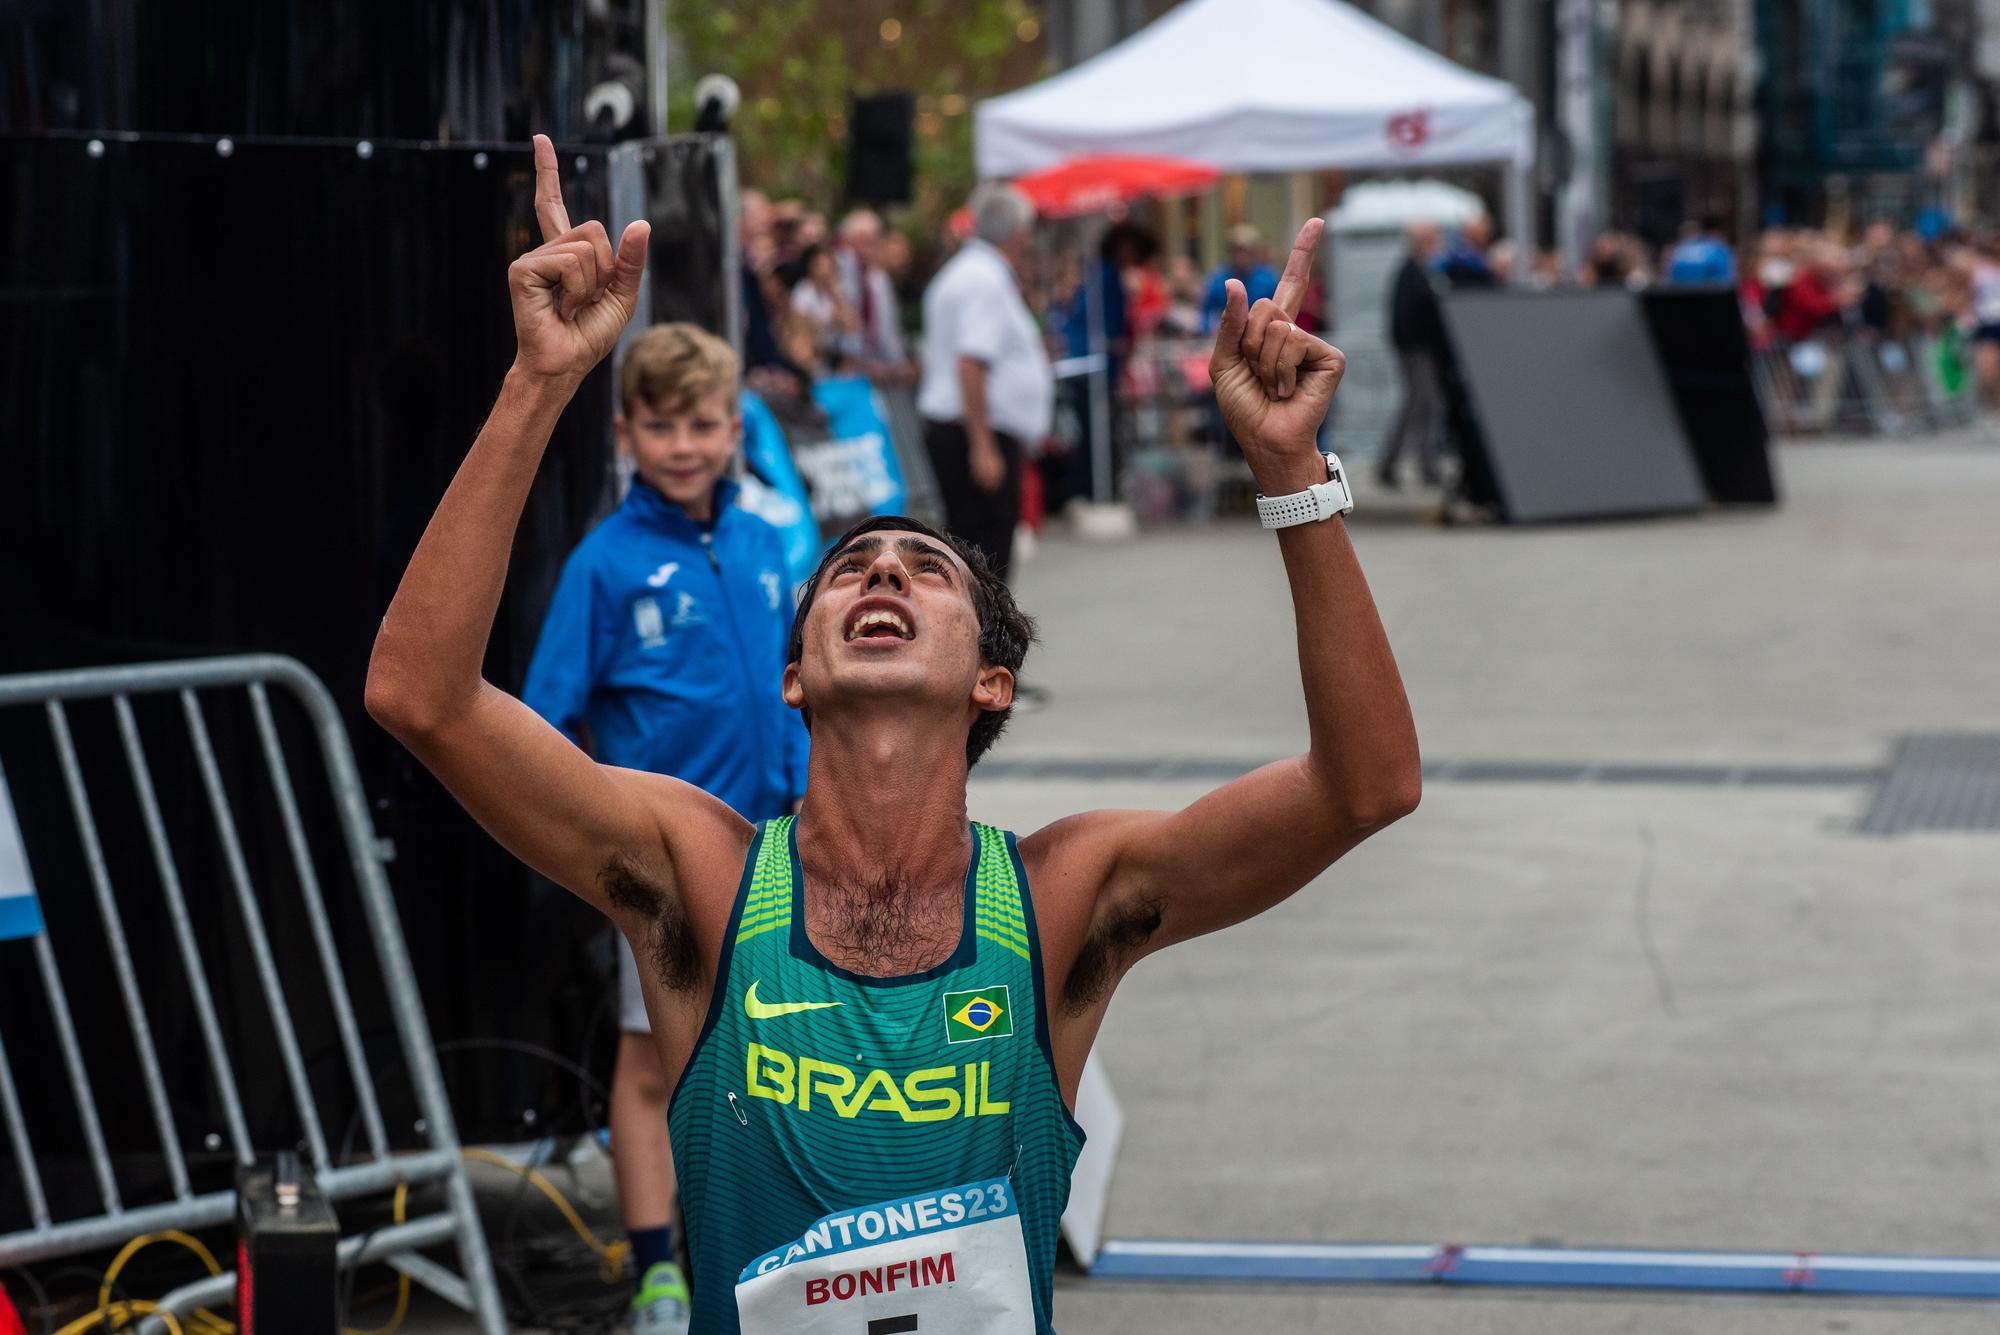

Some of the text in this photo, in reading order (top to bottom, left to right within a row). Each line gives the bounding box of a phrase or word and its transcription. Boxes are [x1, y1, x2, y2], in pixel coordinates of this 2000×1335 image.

[746, 1042, 1011, 1123] BRASIL
[757, 1183, 1008, 1275] CANTONES23
[805, 1251, 956, 1306] BONFIM
